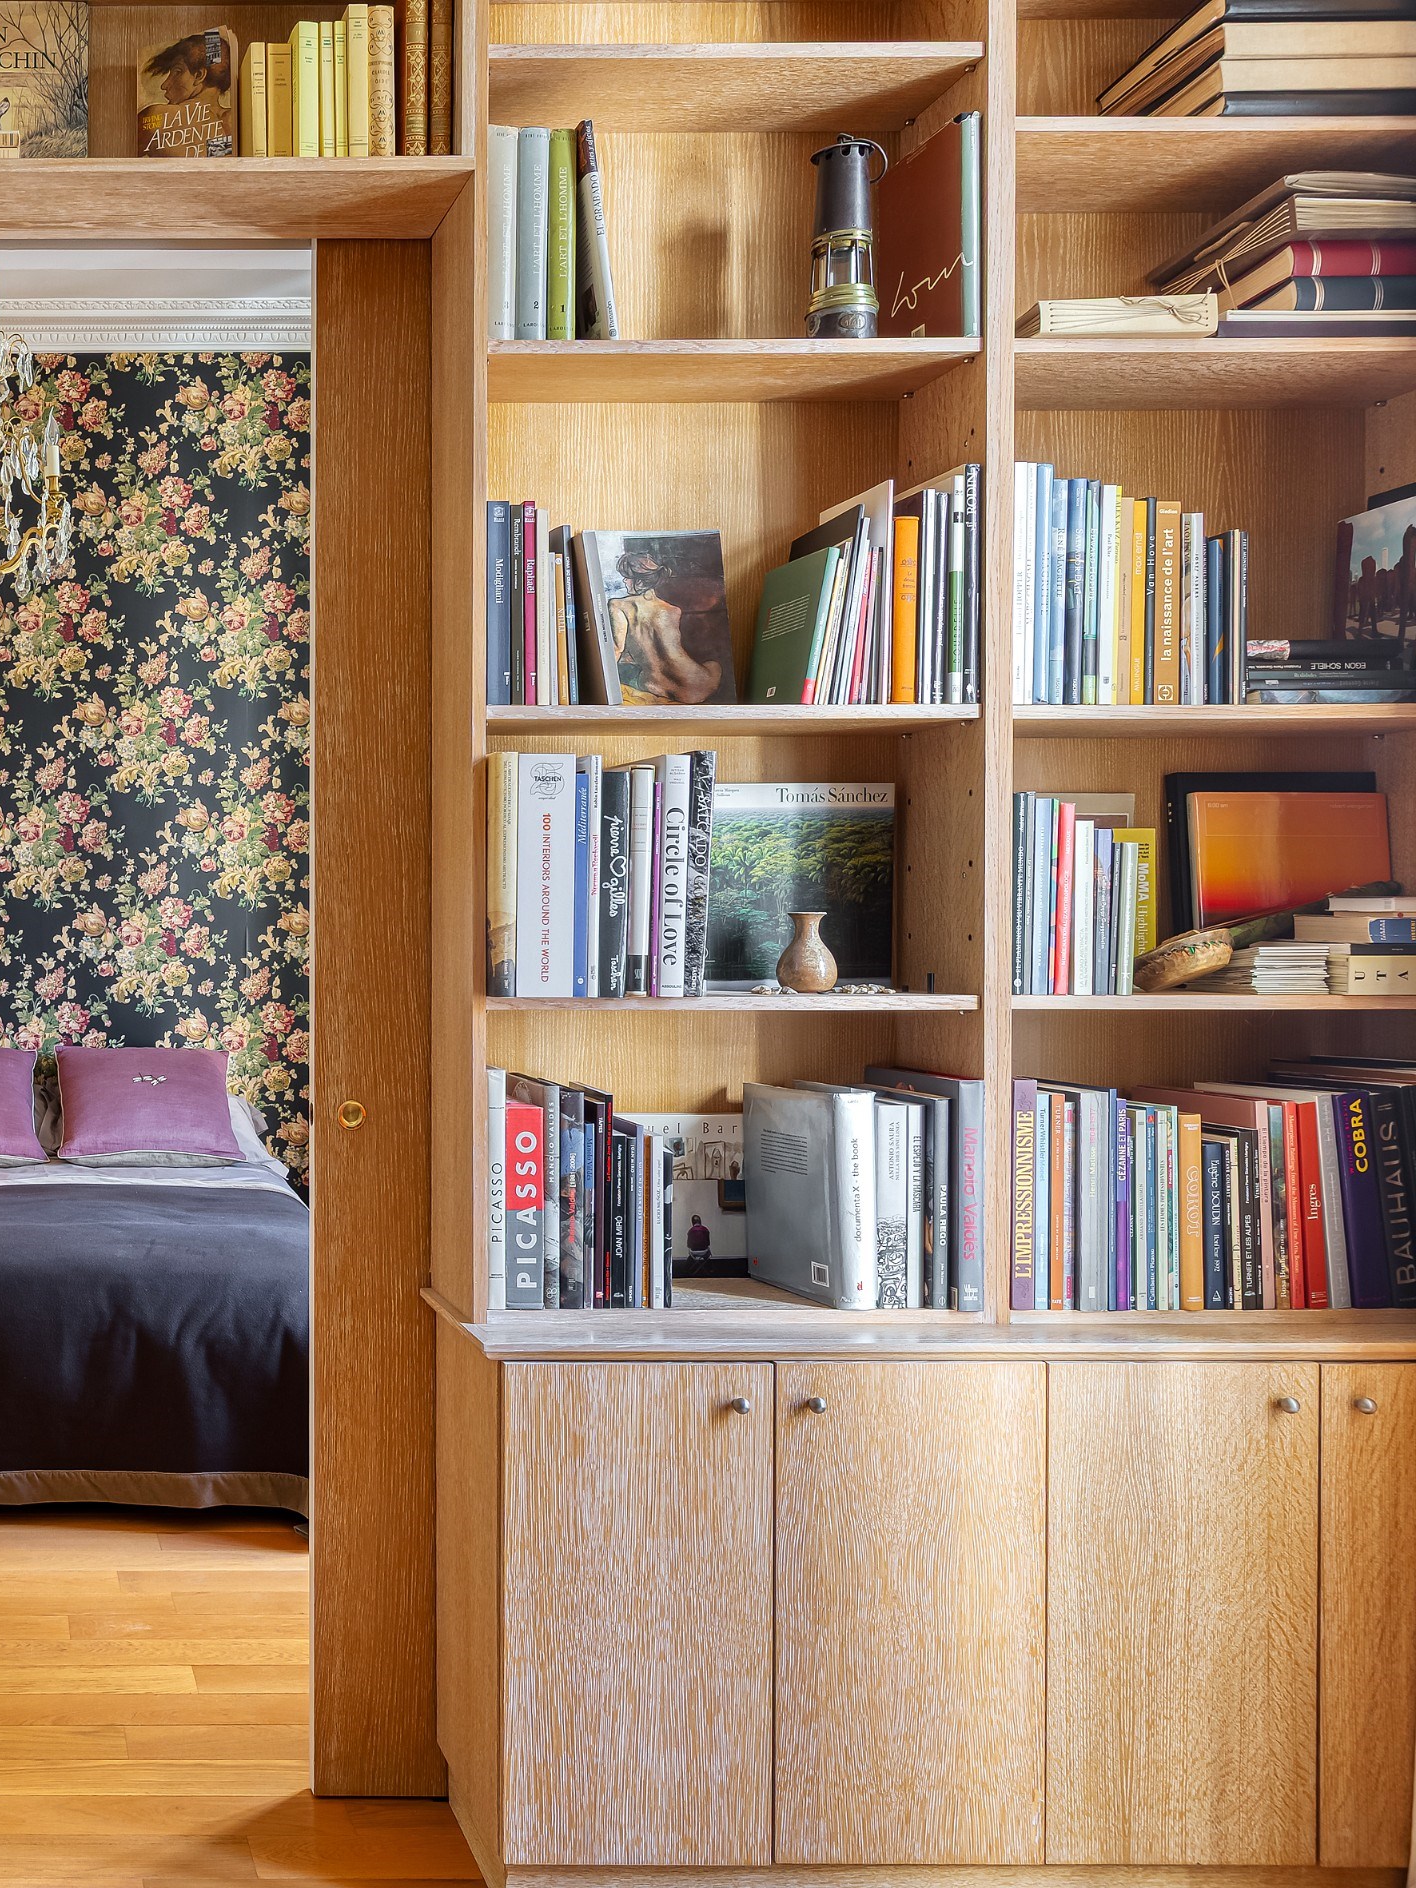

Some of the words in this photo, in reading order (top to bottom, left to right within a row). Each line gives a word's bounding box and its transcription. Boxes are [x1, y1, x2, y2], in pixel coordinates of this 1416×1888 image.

[163, 110, 182, 129] LA
[185, 102, 211, 125] VIE
[144, 120, 223, 152] ARDENTE
[186, 144, 204, 158] DE
[559, 166, 567, 222] L'HOMME
[591, 174, 603, 219] GRABADO
[559, 228, 567, 242] ET
[597, 221, 604, 237] EL
[559, 248, 567, 277] L'ART
[966, 472, 977, 515] RODIN
[513, 519, 521, 555] Rembrandt
[1057, 528, 1065, 551] RENÉ
[1074, 528, 1083, 571] SALVADOR
[1147, 536, 1155, 566] Hove
[1163, 528, 1174, 555] l'art
[495, 559, 504, 603] Modigliani
[526, 559, 535, 594] Raphaël
[1056, 554, 1064, 598] MAGRITTE
[1146, 572, 1155, 595] Van
[1163, 559, 1173, 576] de
[1163, 579, 1172, 646] naissance
[1161, 649, 1172, 660] la
[776, 787, 826, 804] Tomás
[828, 787, 888, 803] Sánchez
[543, 813, 551, 830] 100
[577, 787, 587, 844] Méditerranée
[693, 796, 710, 867] SALGADO
[604, 816, 623, 856] pierre
[665, 807, 685, 870] Circle
[542, 834, 550, 881] INTERIORS
[602, 878, 623, 917] gilles
[664, 883, 684, 907] of
[1138, 863, 1149, 901] MoMA
[541, 884, 550, 925] AROUND
[541, 928, 549, 946] THE
[663, 913, 682, 965] Love
[1137, 905, 1147, 954] Highlights
[541, 948, 549, 982] WORLD
[610, 955, 620, 990] Taschen
[1118, 1109, 1126, 1131] PARIS
[1349, 1099, 1368, 1173] COBRA
[963, 1127, 979, 1196] Manolo
[1118, 1145, 1126, 1181] CÉZANNE
[491, 1163, 502, 1243] PICASSO
[515, 1131, 537, 1288] PICASSO
[1015, 1110, 1034, 1279] L'IMPRESSIONNISME
[1186, 1166, 1200, 1237] COROT
[1308, 1184, 1318, 1220] Ingres
[1380, 1121, 1414, 1284] BAUHAUS
[615, 1216, 624, 1234] MIRÓ
[963, 1203, 978, 1260] Valdés
[615, 1237, 623, 1258] JOAN
